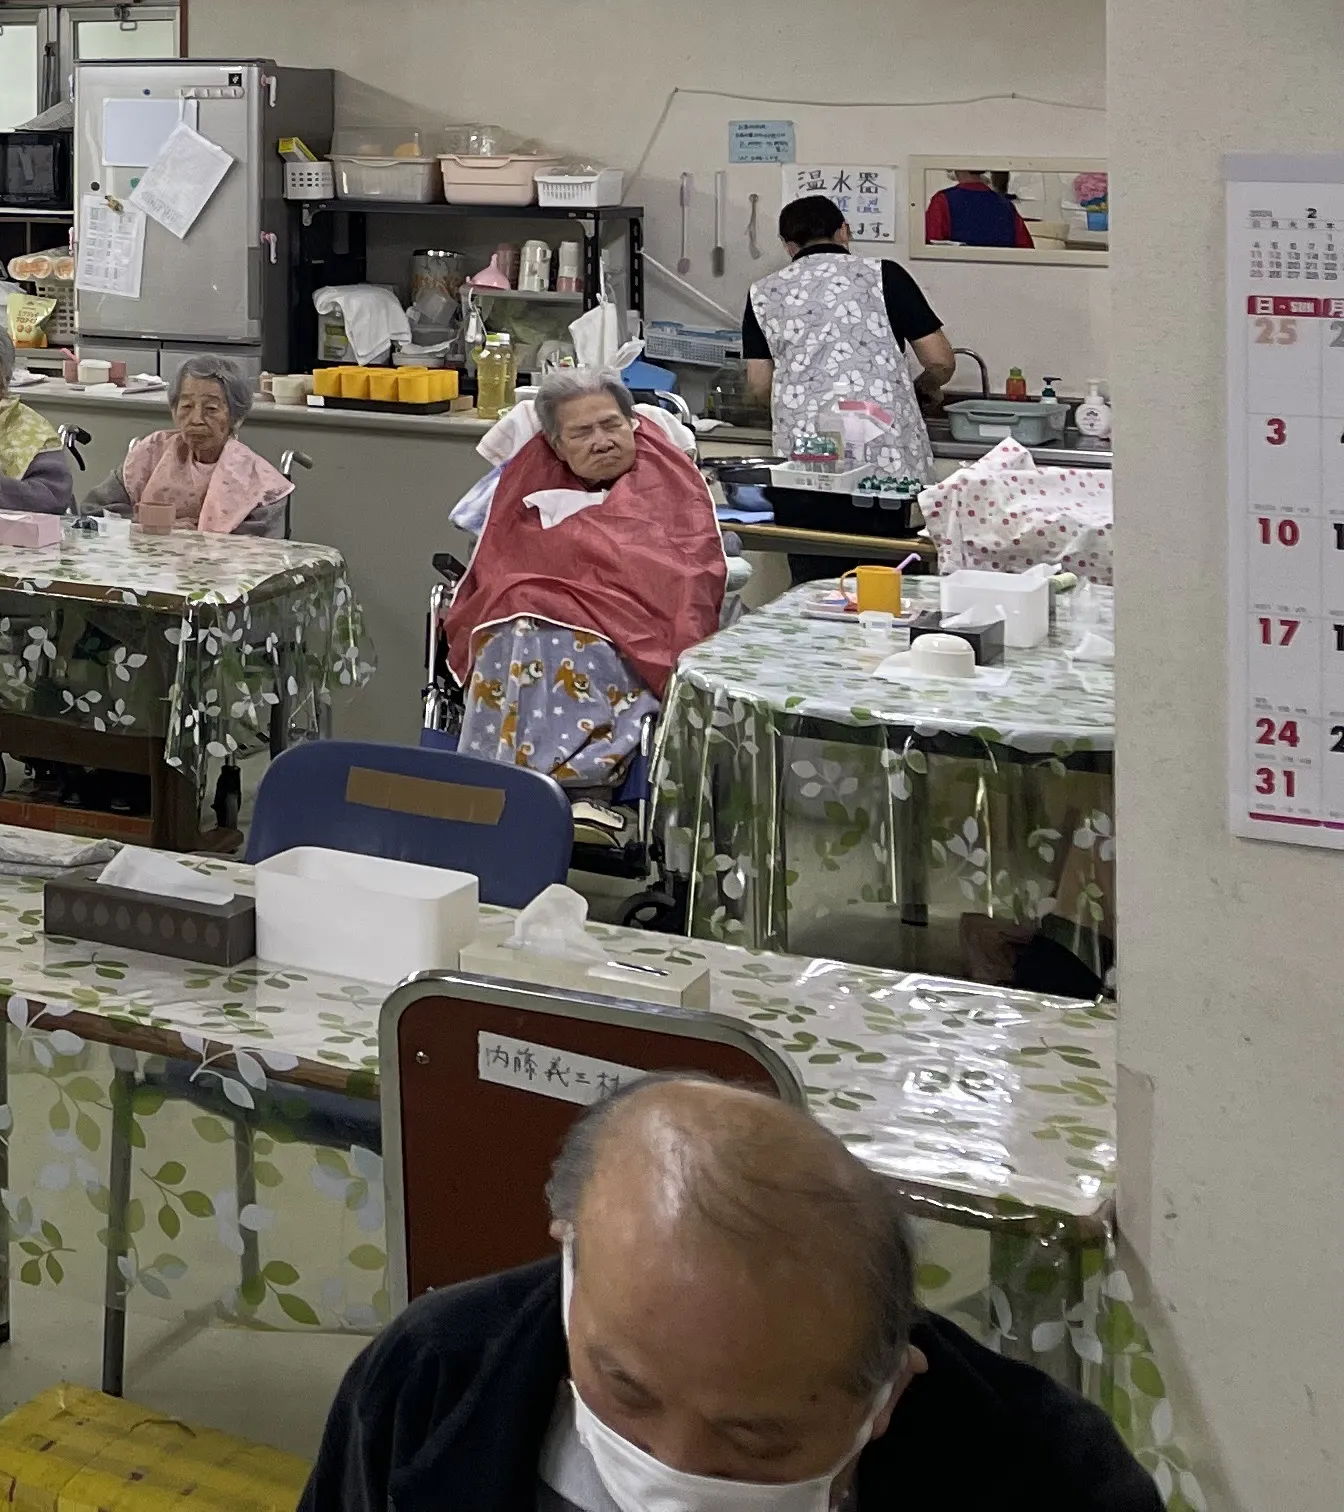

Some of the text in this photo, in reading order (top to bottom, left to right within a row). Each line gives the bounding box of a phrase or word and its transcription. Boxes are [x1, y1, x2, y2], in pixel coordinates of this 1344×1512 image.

[797, 169, 888, 194] 温水器
[1307, 207, 1318, 219] 2
[1254, 317, 1344, 348] 25 2
[1266, 417, 1287, 445] 3
[1258, 517, 1344, 550] 10 1
[1259, 617, 1344, 651] 17 1
[1255, 717, 1344, 753] 24 2
[1255, 767, 1295, 797] 31
